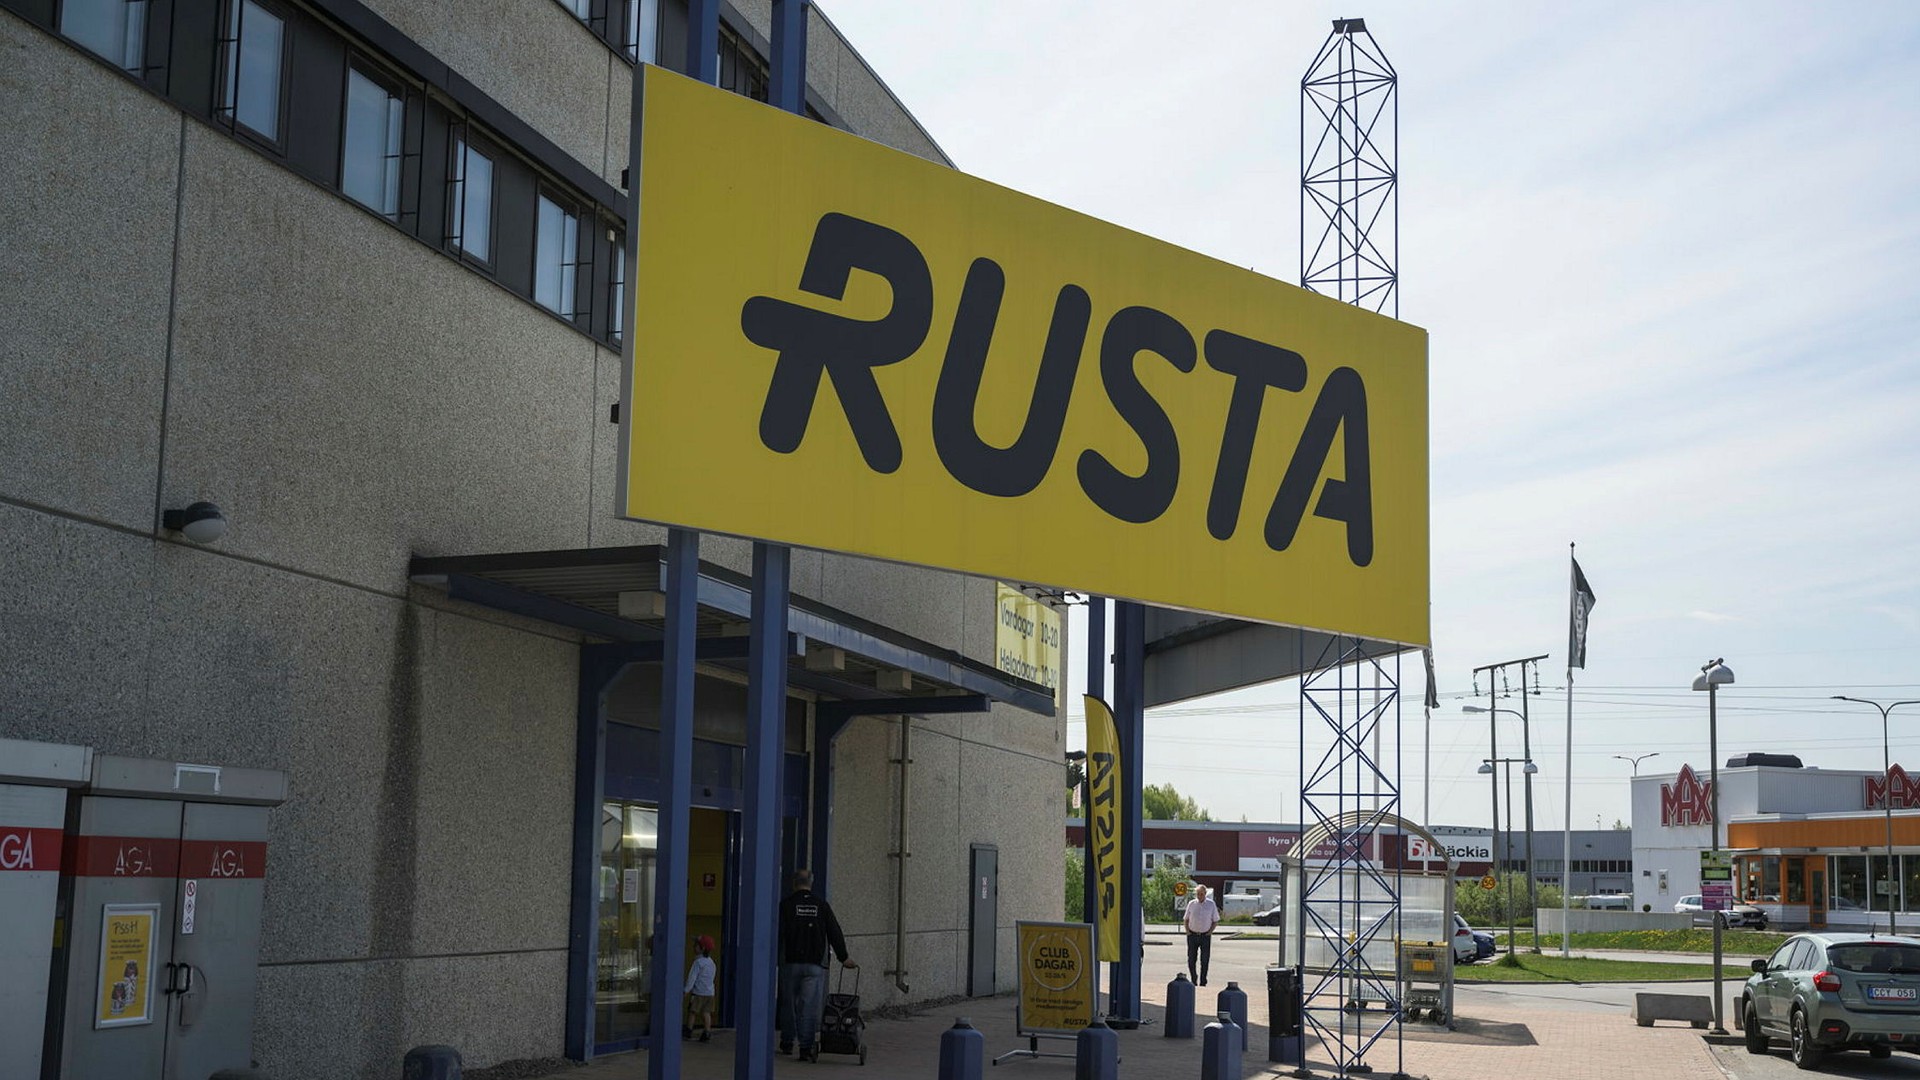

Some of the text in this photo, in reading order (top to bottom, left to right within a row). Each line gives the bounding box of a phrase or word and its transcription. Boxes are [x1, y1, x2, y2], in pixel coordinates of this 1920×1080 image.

[741, 212, 1374, 567] RUSTA
[1001, 602, 1058, 649] Vardagar 10-20
[1661, 763, 1714, 826] MAX
[1865, 763, 1920, 809] MAX
[114, 841, 152, 875] AGA
[1268, 836, 1290, 847] Hyra
[210, 846, 244, 876] AGA
[1034, 959, 1075, 971] DAGAR
[1040, 947, 1069, 959] CLUB
